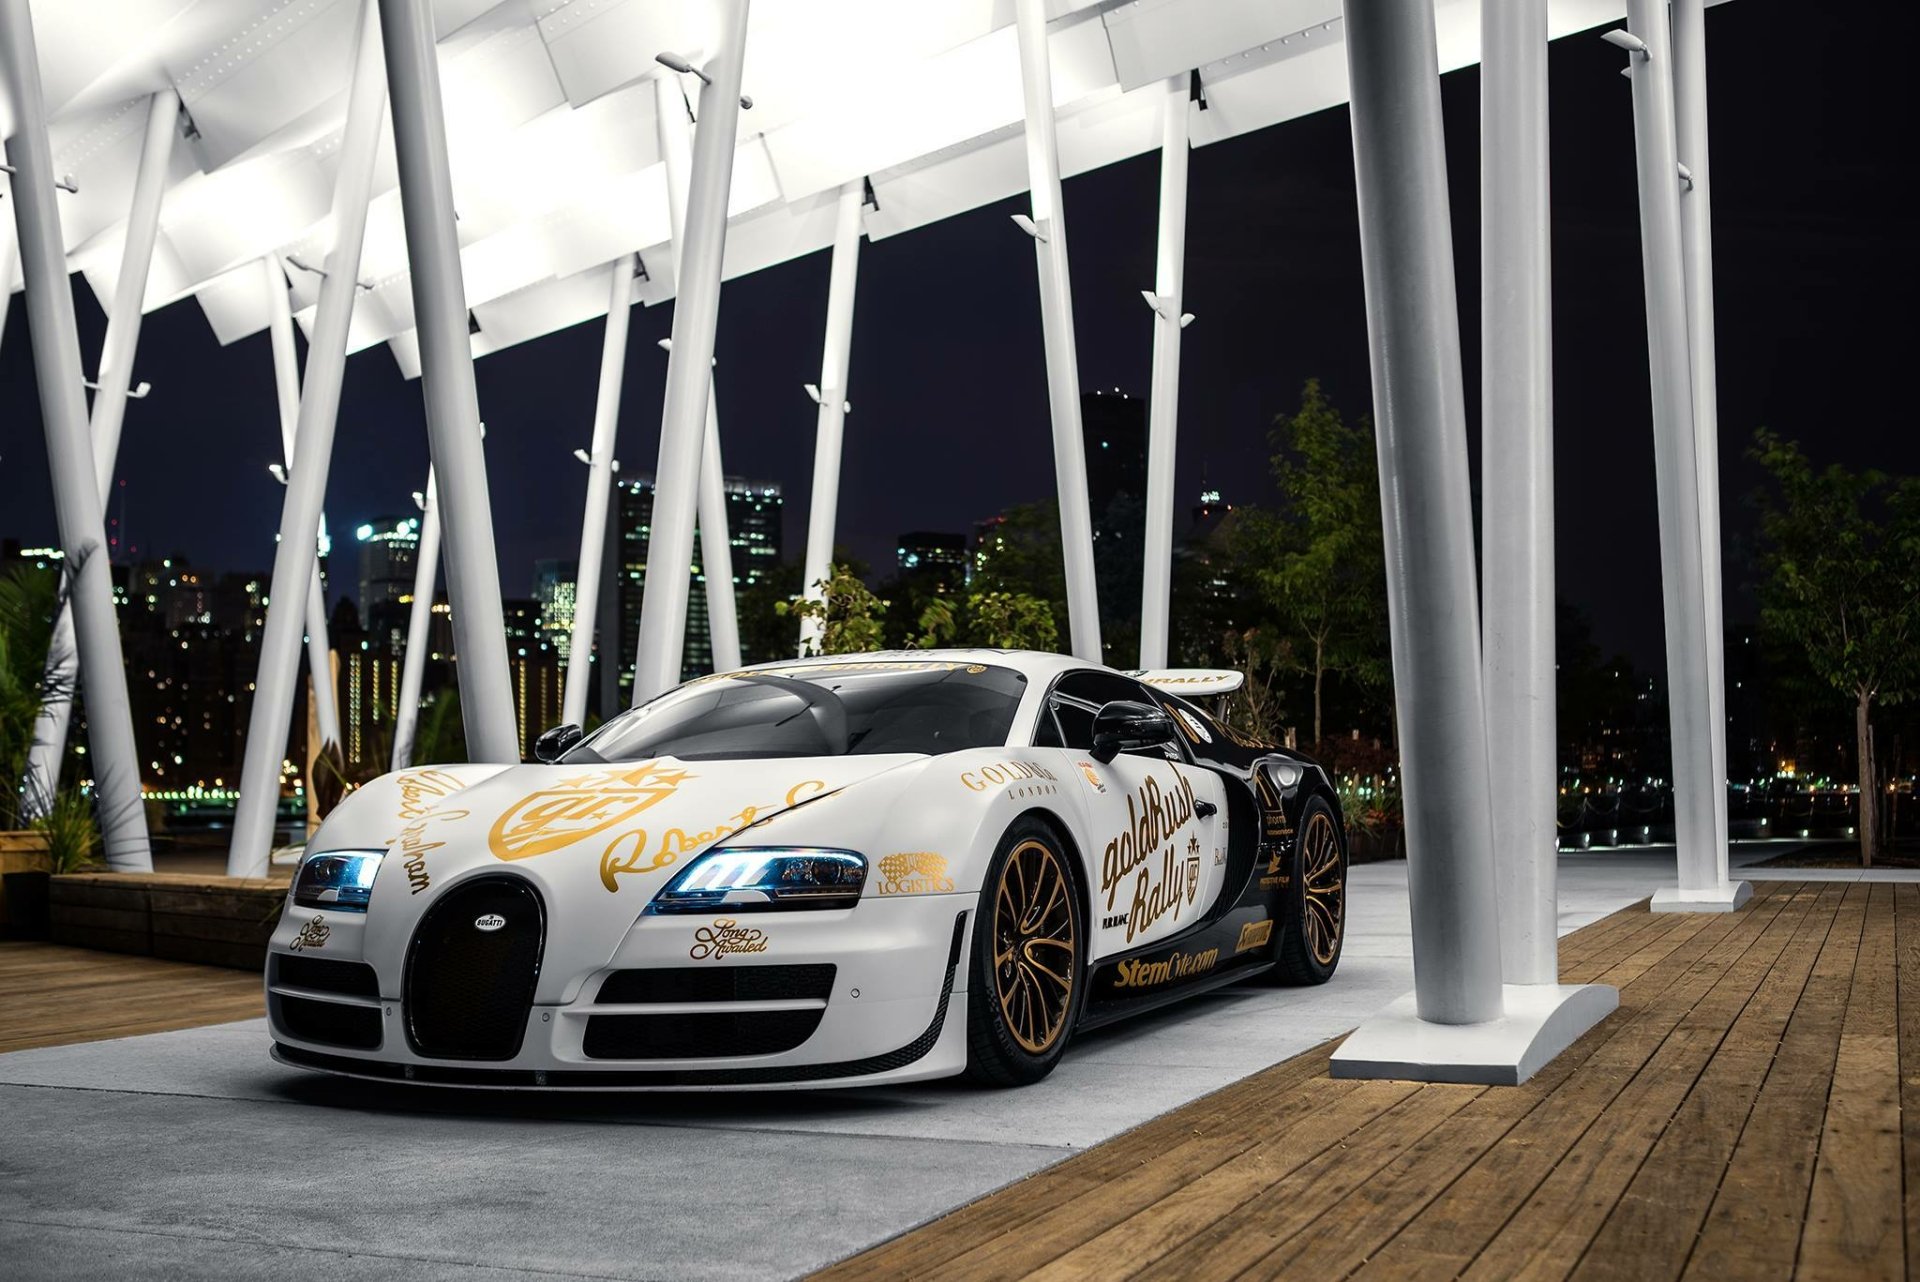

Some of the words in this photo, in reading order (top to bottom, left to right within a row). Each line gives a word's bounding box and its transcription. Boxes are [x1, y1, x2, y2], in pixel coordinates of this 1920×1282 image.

[1008, 784, 1058, 800] LONDON
[877, 877, 955, 895] LOGISTICS
[1126, 843, 1185, 944] Rally
[477, 919, 503, 927] BUGATTI
[695, 918, 762, 945] Long
[690, 936, 768, 960] Awaited
